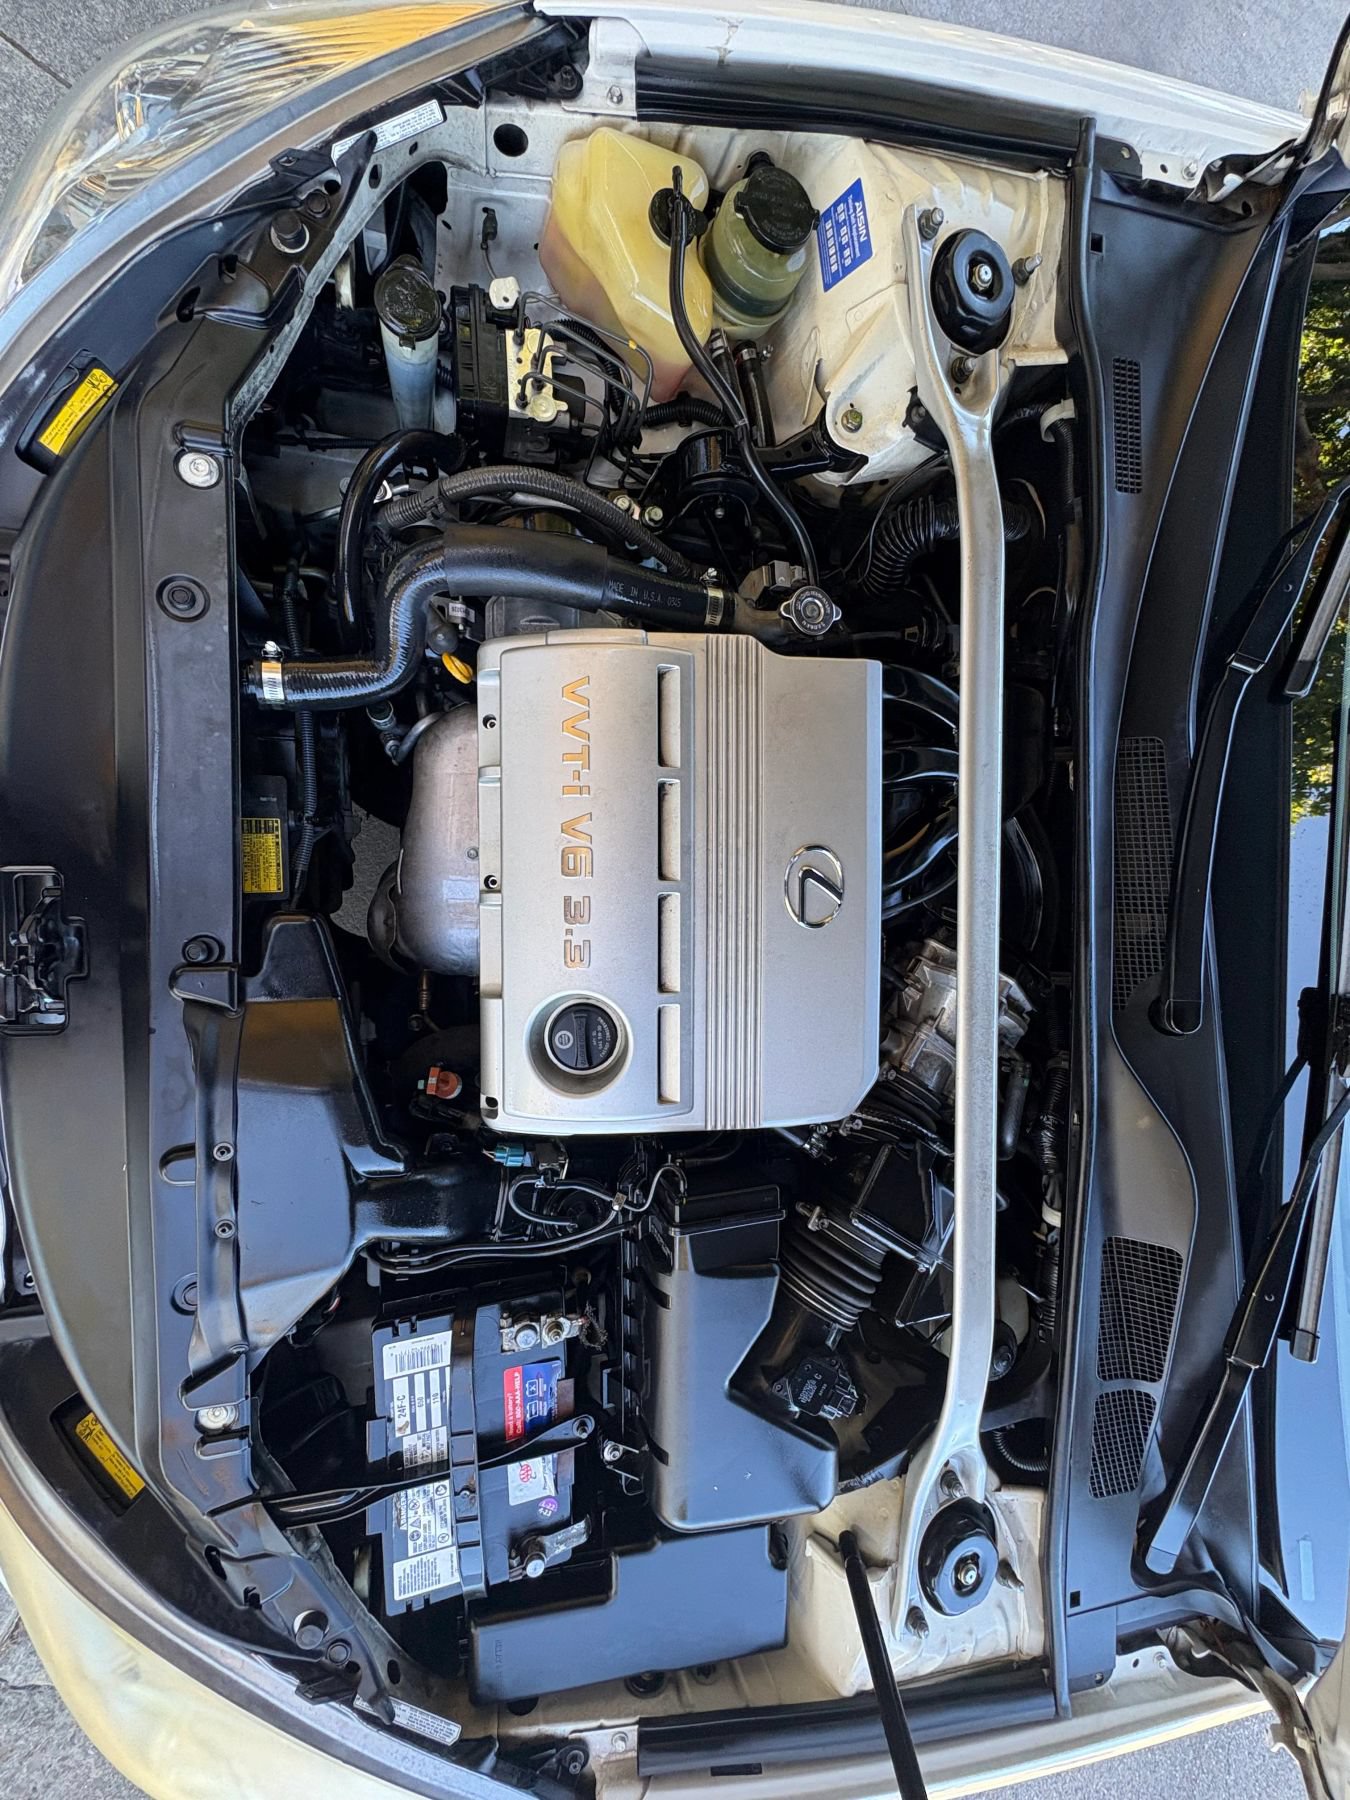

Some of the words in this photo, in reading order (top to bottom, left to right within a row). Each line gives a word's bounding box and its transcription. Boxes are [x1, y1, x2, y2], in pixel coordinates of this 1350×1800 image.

[854, 200, 867, 242] AISIN
[608, 579, 625, 593] MADE
[630, 586, 640, 597] IN
[561, 675, 592, 798] VVT-i
[560, 811, 595, 880] V6
[562, 894, 592, 970] 3.3
[396, 1395, 407, 1418] 24F-C
